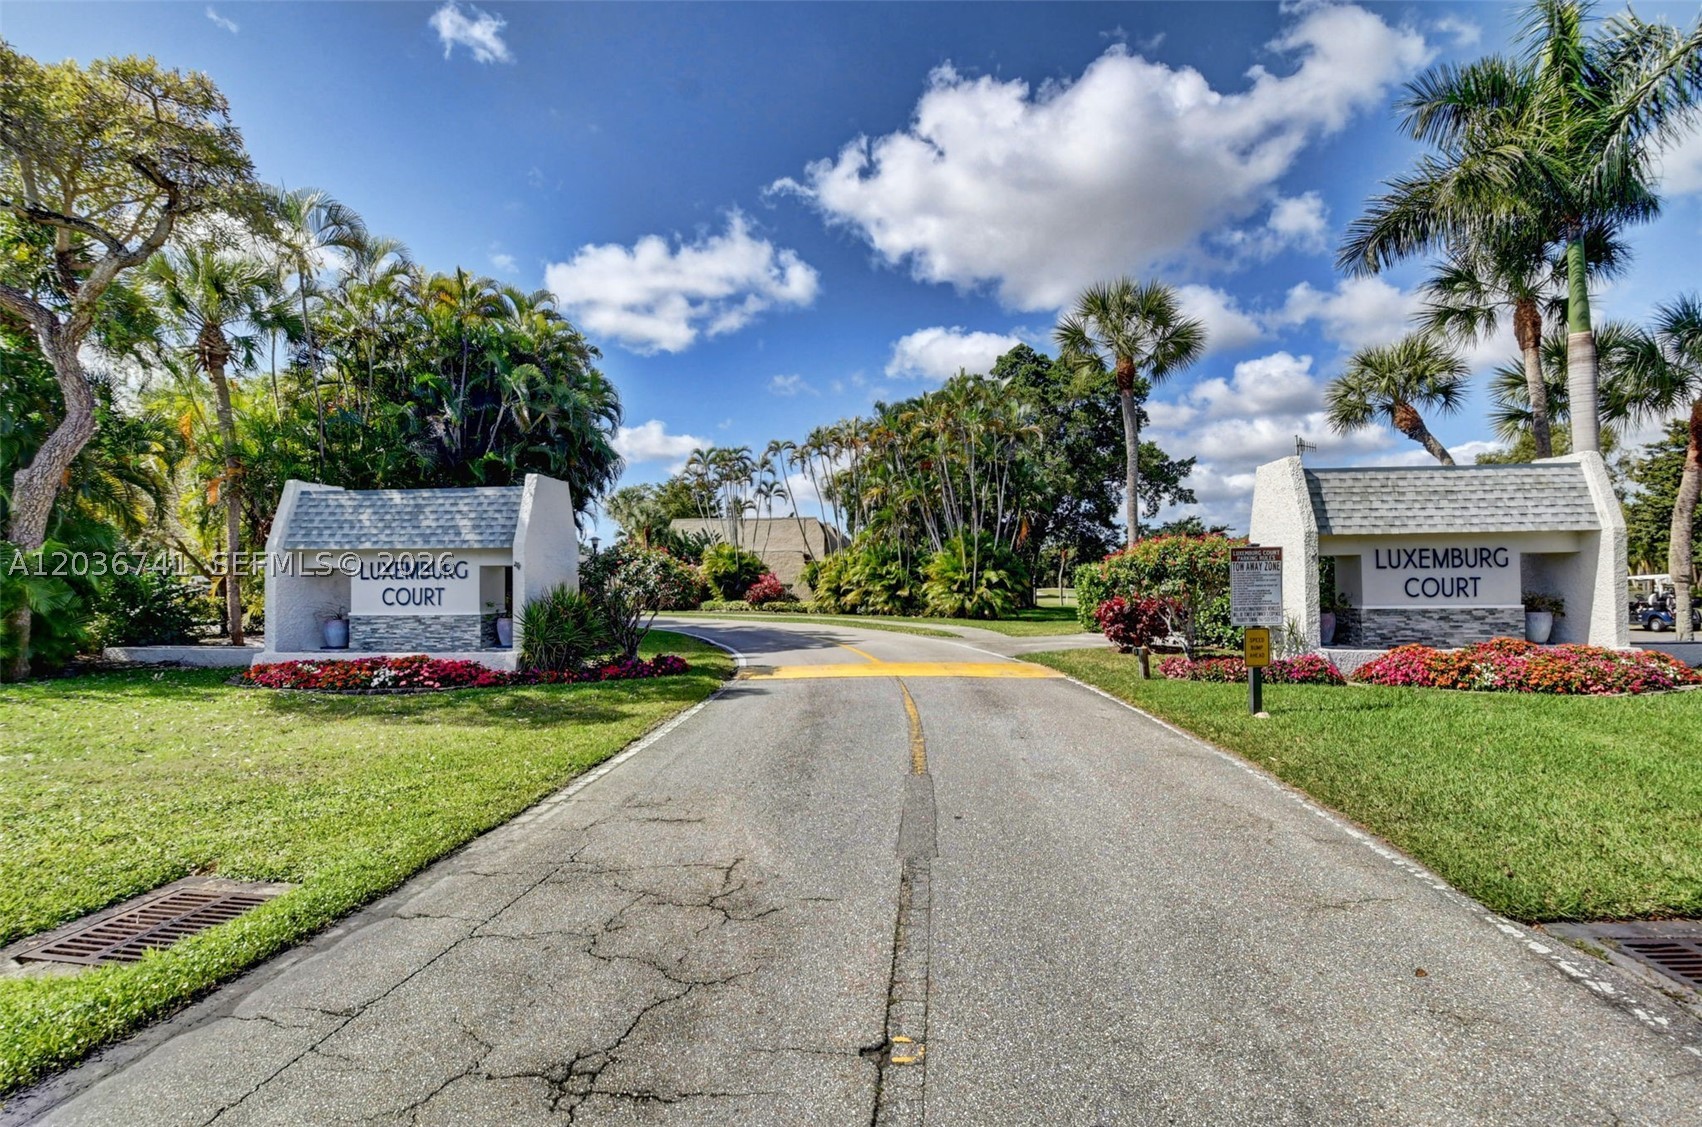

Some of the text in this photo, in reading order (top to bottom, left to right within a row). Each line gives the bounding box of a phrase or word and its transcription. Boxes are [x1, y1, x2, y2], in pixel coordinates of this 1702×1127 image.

[1232, 561, 1280, 571] TOW AWAY ZONE
[1374, 547, 1510, 570] LUXEMBURG
[360, 561, 469, 580] LUXEMBURG
[382, 587, 445, 606] COURT
[1404, 577, 1482, 598] COURT
